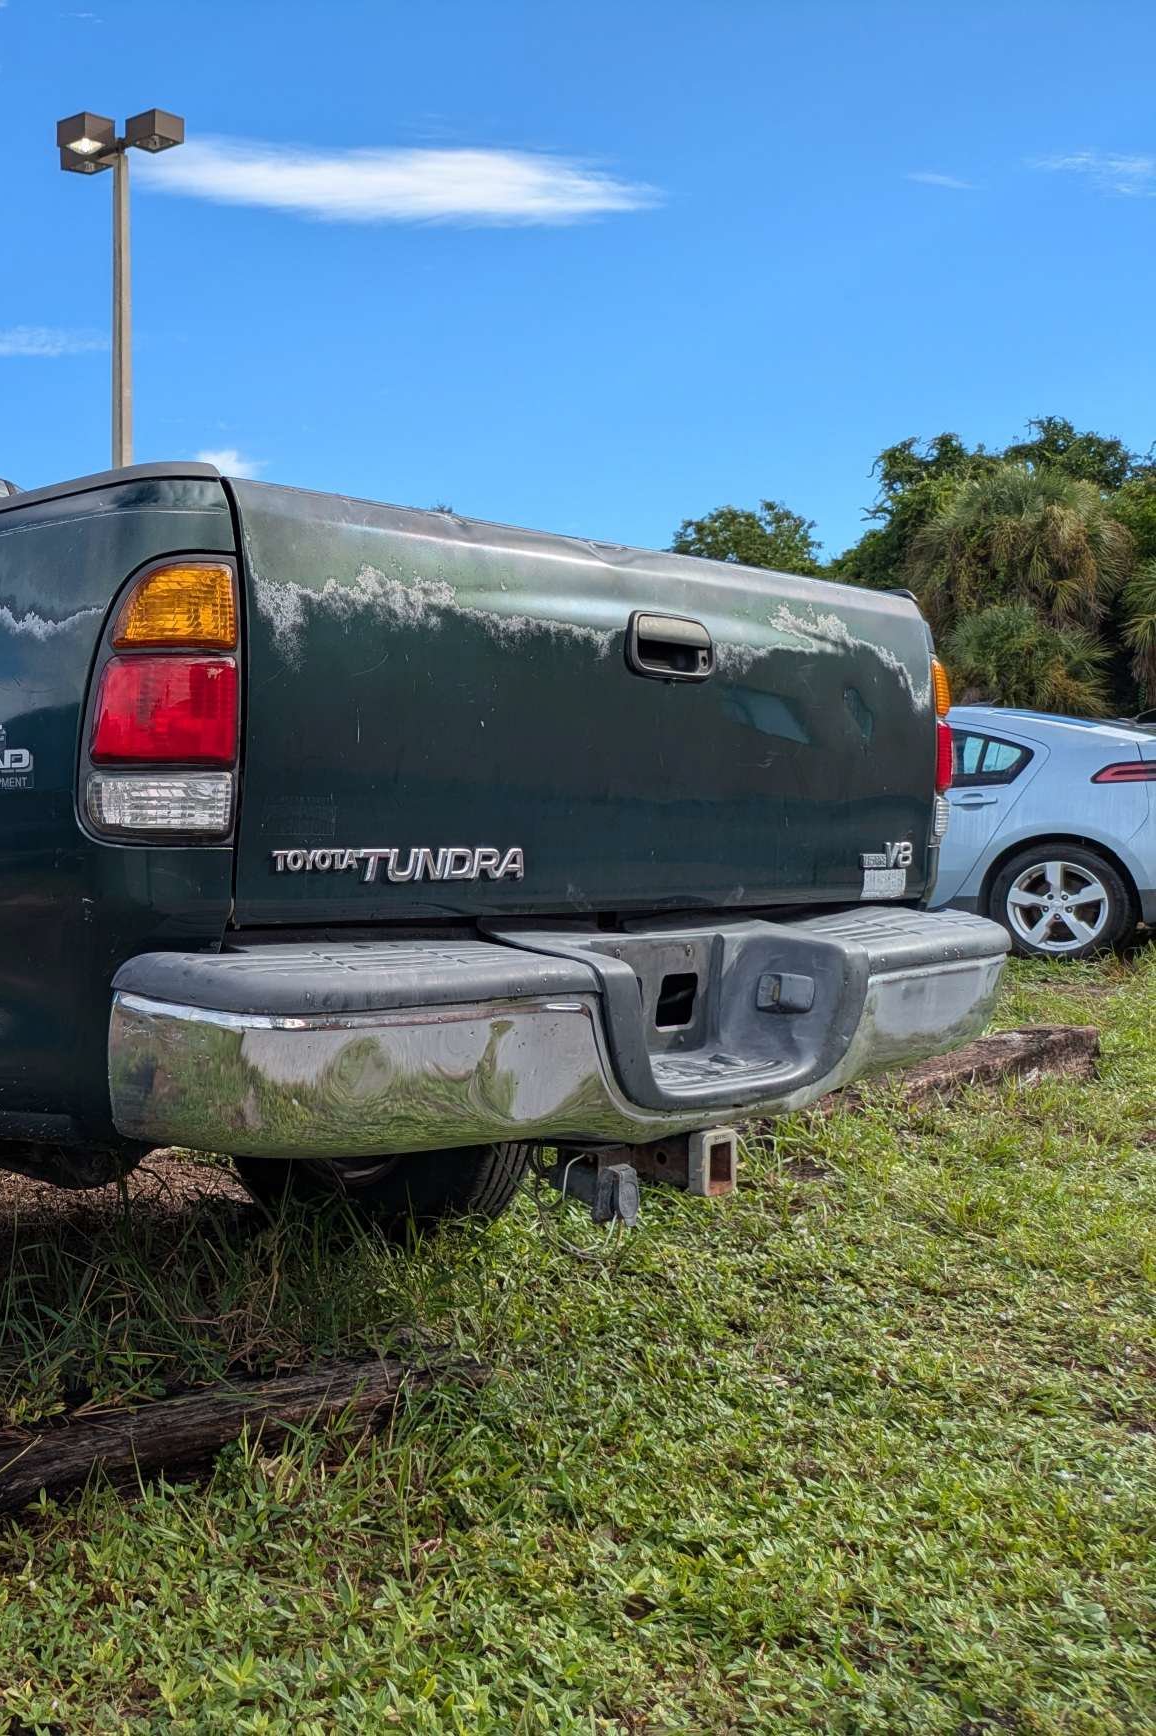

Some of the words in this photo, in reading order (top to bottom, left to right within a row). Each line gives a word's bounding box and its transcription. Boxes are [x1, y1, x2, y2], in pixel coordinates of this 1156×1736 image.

[272, 849, 358, 872] TOYOTA
[359, 847, 524, 882] TUNDRA
[884, 841, 913, 869] V8
